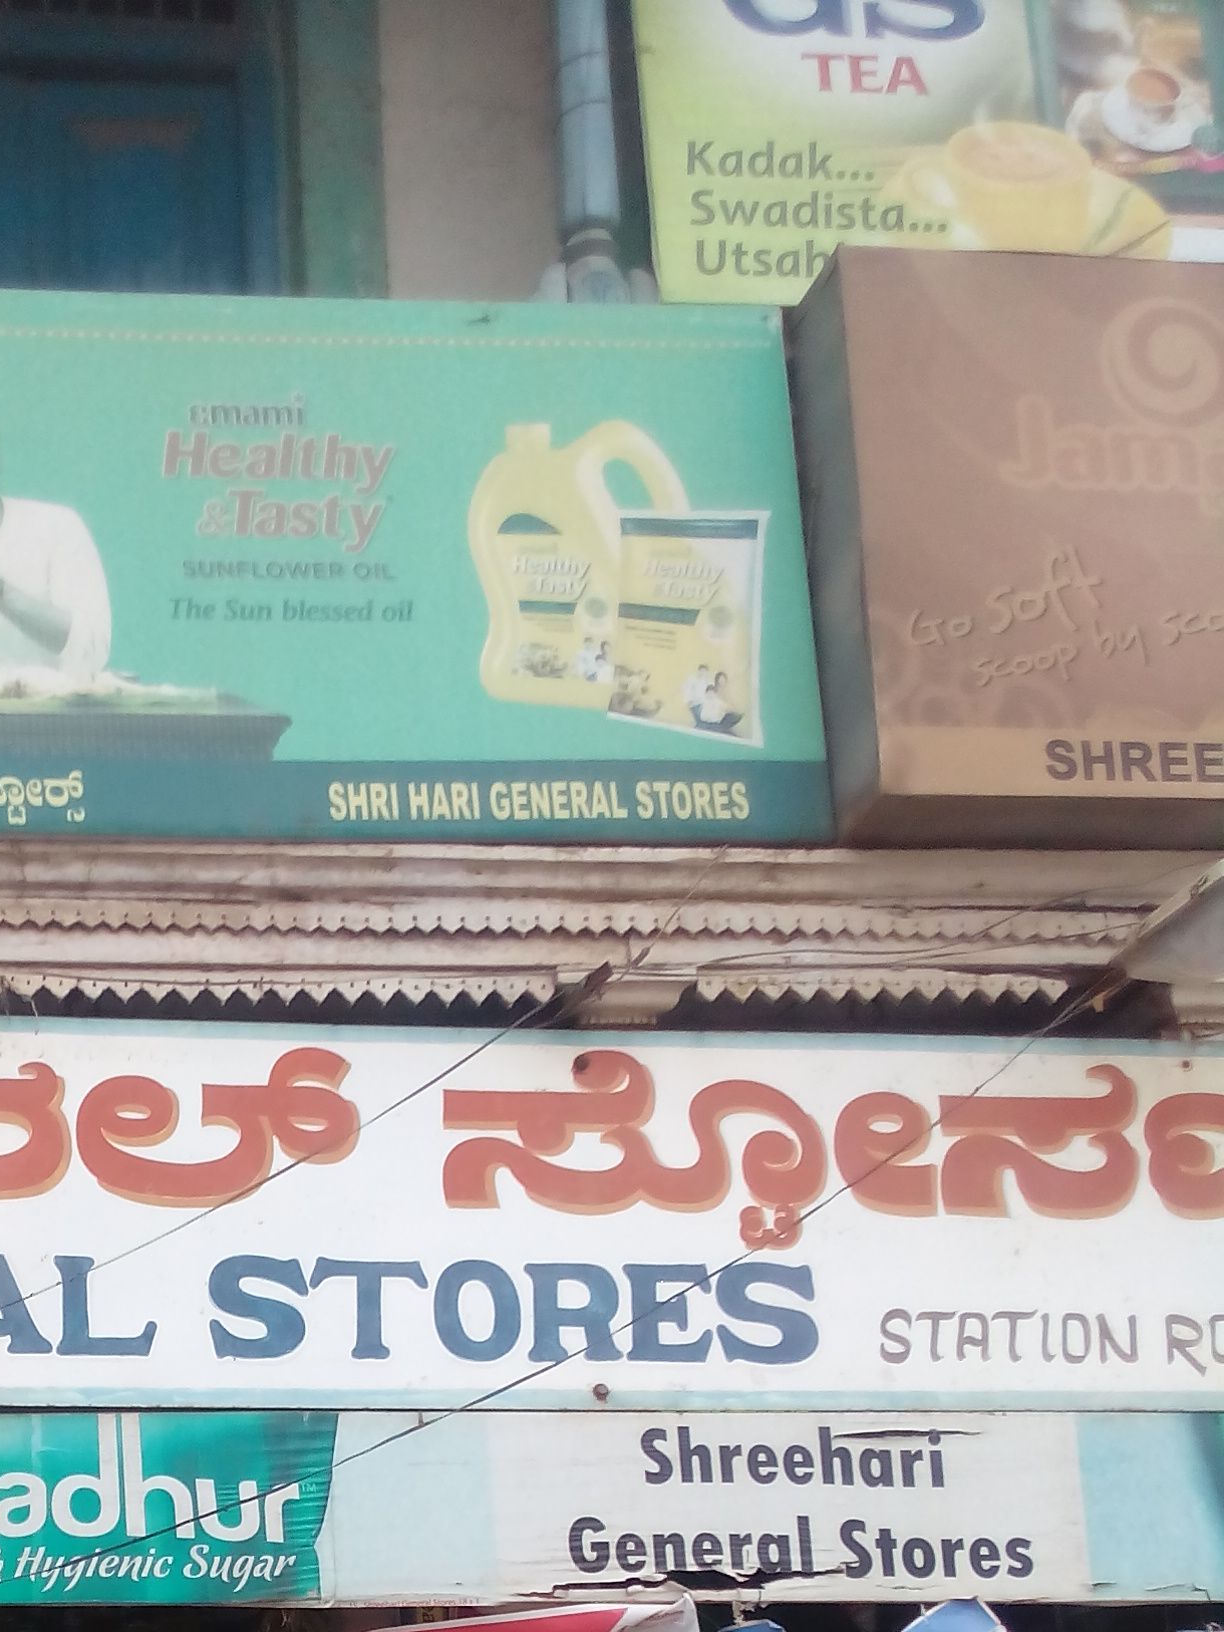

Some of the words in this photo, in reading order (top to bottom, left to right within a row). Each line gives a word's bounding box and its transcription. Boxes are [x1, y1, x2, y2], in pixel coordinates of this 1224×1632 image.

[801, 53, 929, 95] TEA
[687, 141, 875, 182] Kadak...
[690, 189, 948, 233] Swadista...
[162, 430, 395, 495] Healthy
[182, 559, 344, 582] SUNFLOWER
[353, 560, 397, 582] OIL
[171, 598, 218, 622] The
[223, 599, 274, 623] Sun
[282, 599, 376, 623] blessed
[381, 599, 414, 624] oil
[328, 781, 399, 821] SHRI
[408, 781, 480, 821] HARI
[490, 781, 627, 821] GENERAL
[635, 781, 750, 821] STORES
[209, 1254, 820, 1365] STORES
[879, 1309, 1140, 1365] STATION
[639, 1425, 946, 1488] Shreehari
[13, 1545, 175, 1593] Hygienic
[182, 1545, 297, 1583] Sugar
[568, 1514, 817, 1575] General
[839, 1518, 1034, 1580] Stores
